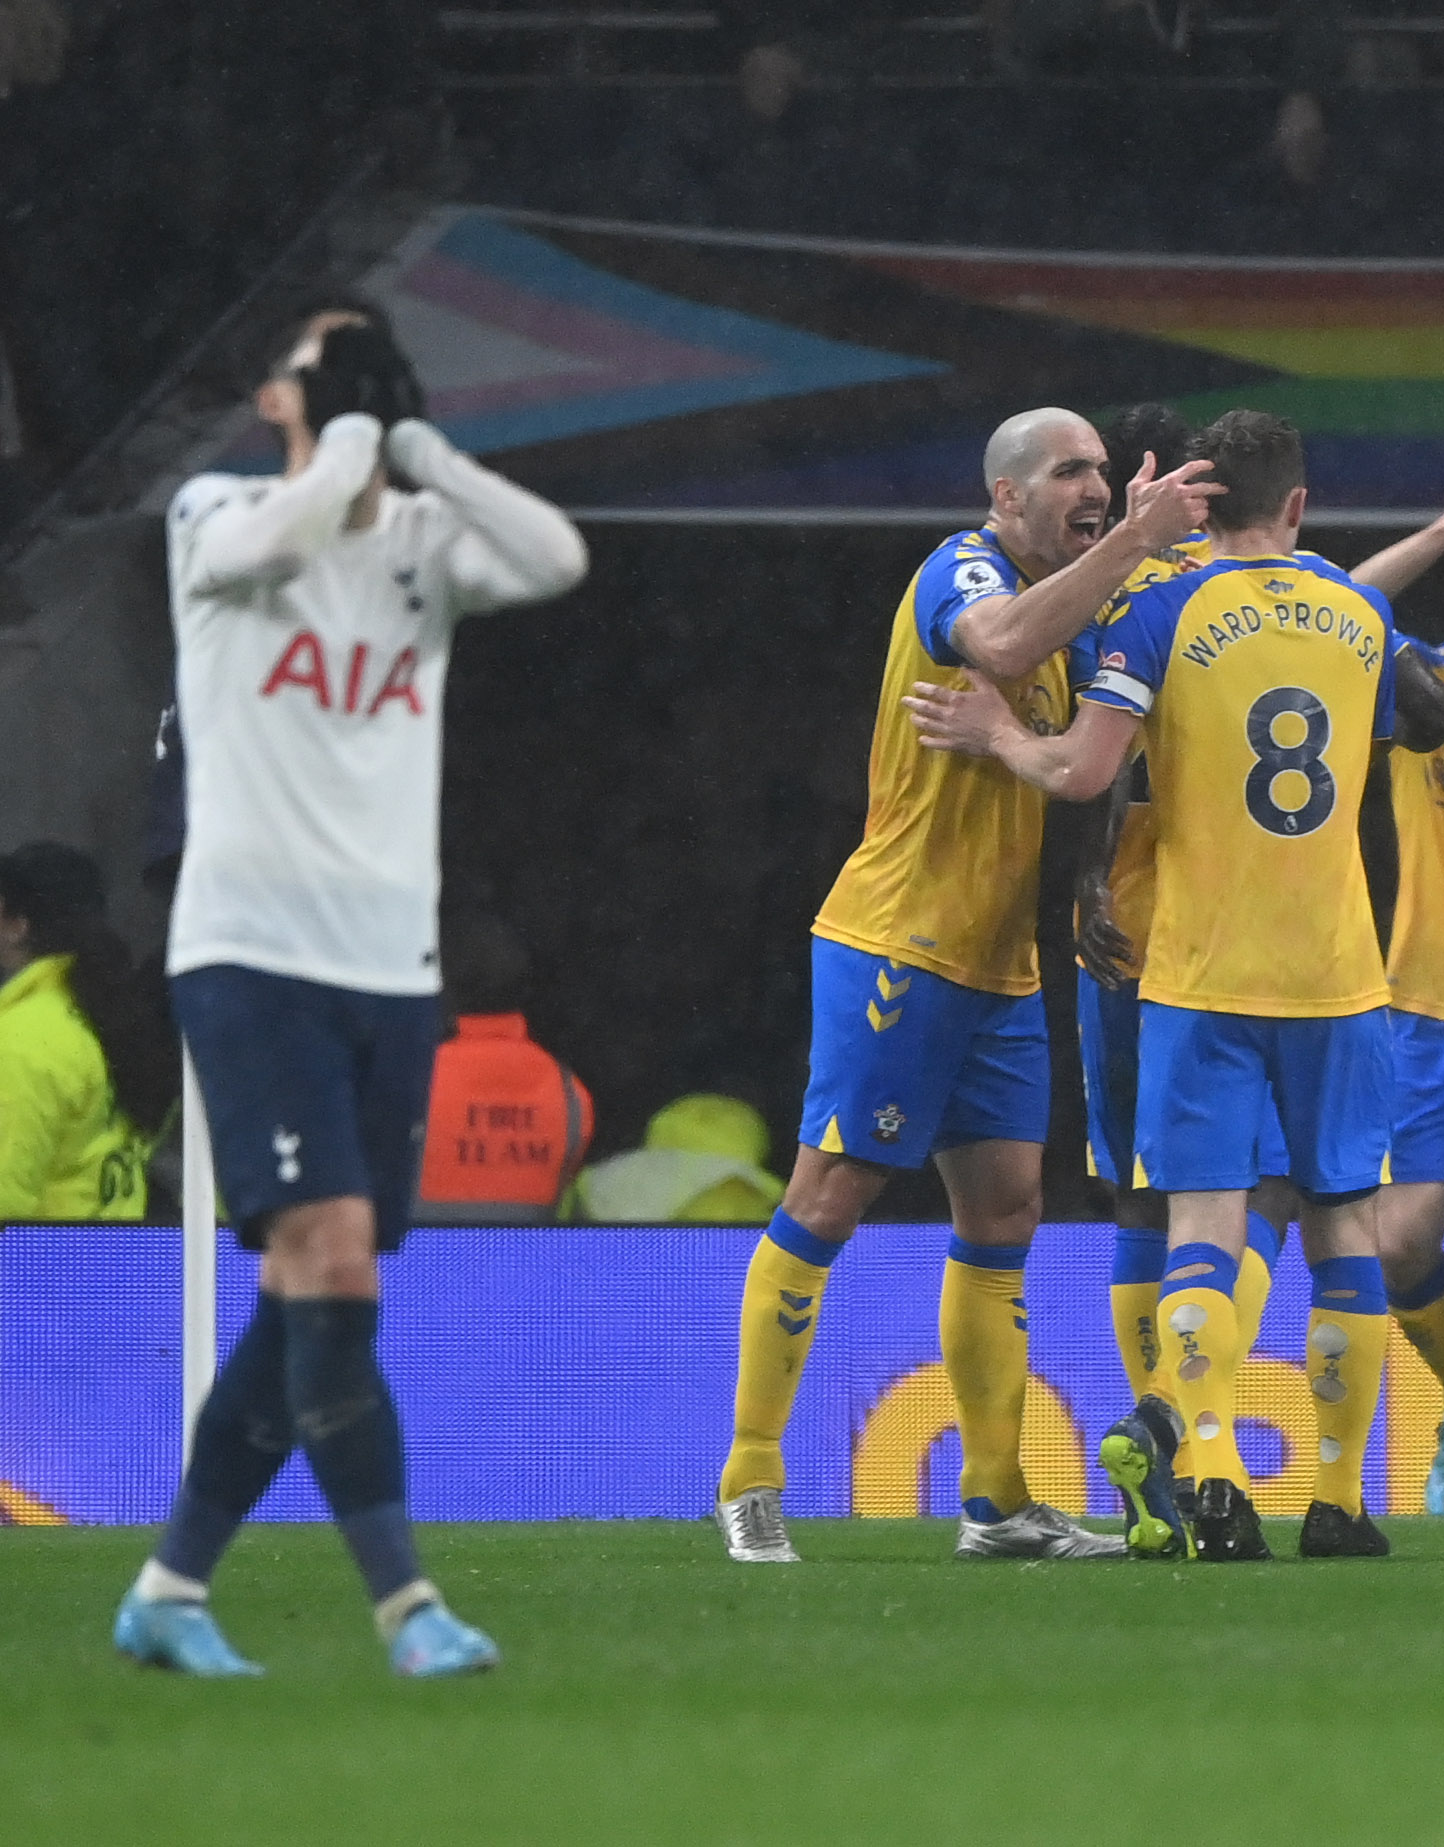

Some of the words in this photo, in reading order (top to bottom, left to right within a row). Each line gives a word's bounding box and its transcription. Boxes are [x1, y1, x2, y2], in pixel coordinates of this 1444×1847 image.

[1182, 602, 1379, 669] WARD-PROWSE
[260, 630, 424, 717] AIA
[1244, 685, 1337, 838] 8
[467, 1103, 539, 1130] FIRE
[456, 1137, 552, 1165] TEAM
